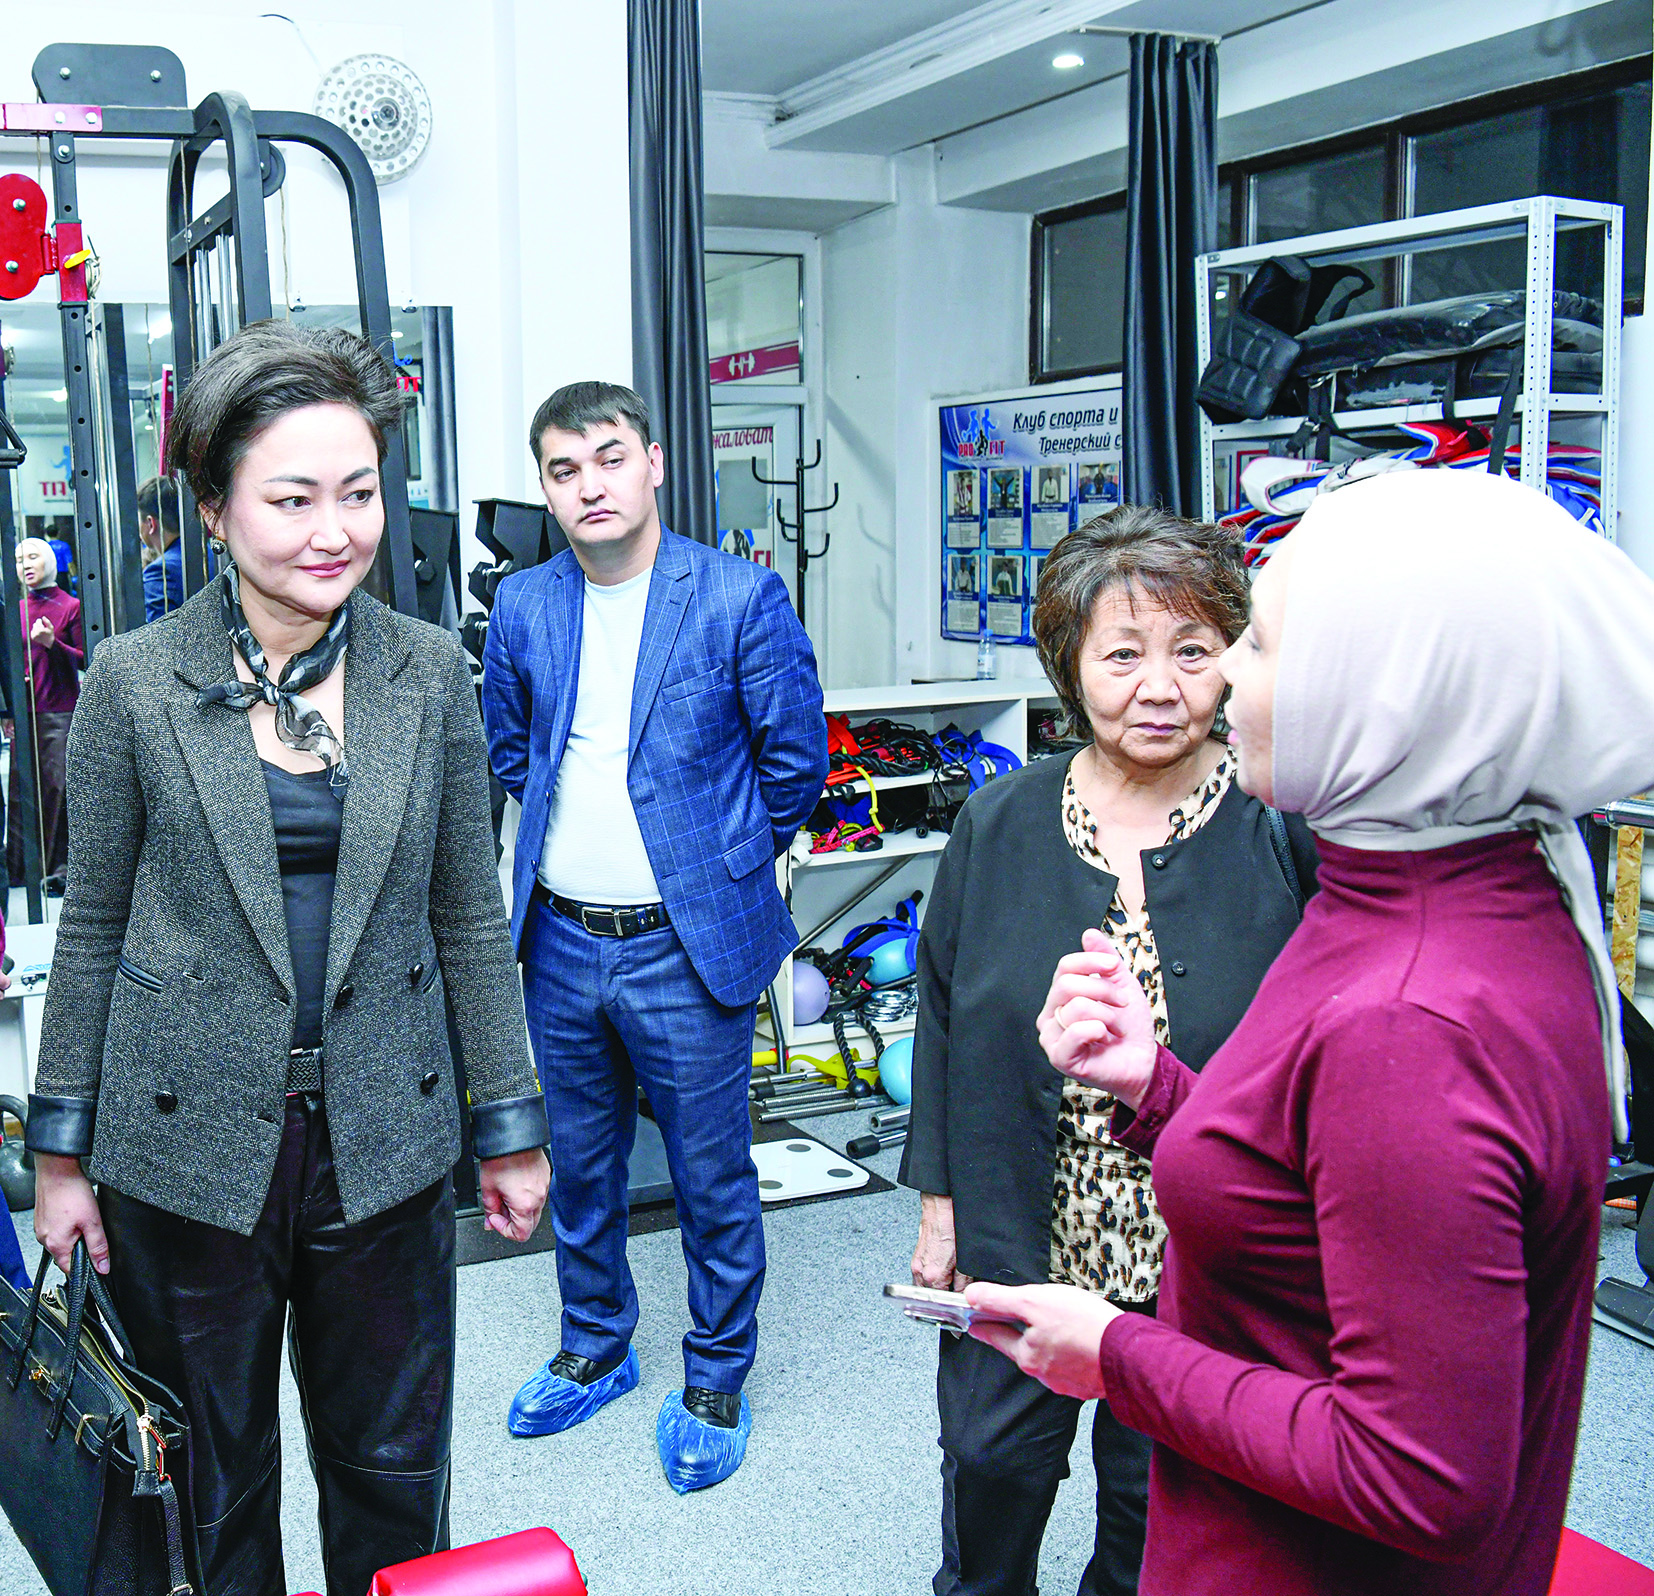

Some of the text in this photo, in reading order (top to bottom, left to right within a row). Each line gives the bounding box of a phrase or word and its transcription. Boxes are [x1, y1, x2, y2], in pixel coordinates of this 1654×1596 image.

[1013, 407, 1118, 431] Клуб спорта и
[989, 440, 1005, 454] FIT
[1040, 432, 1111, 453] Тренерский
